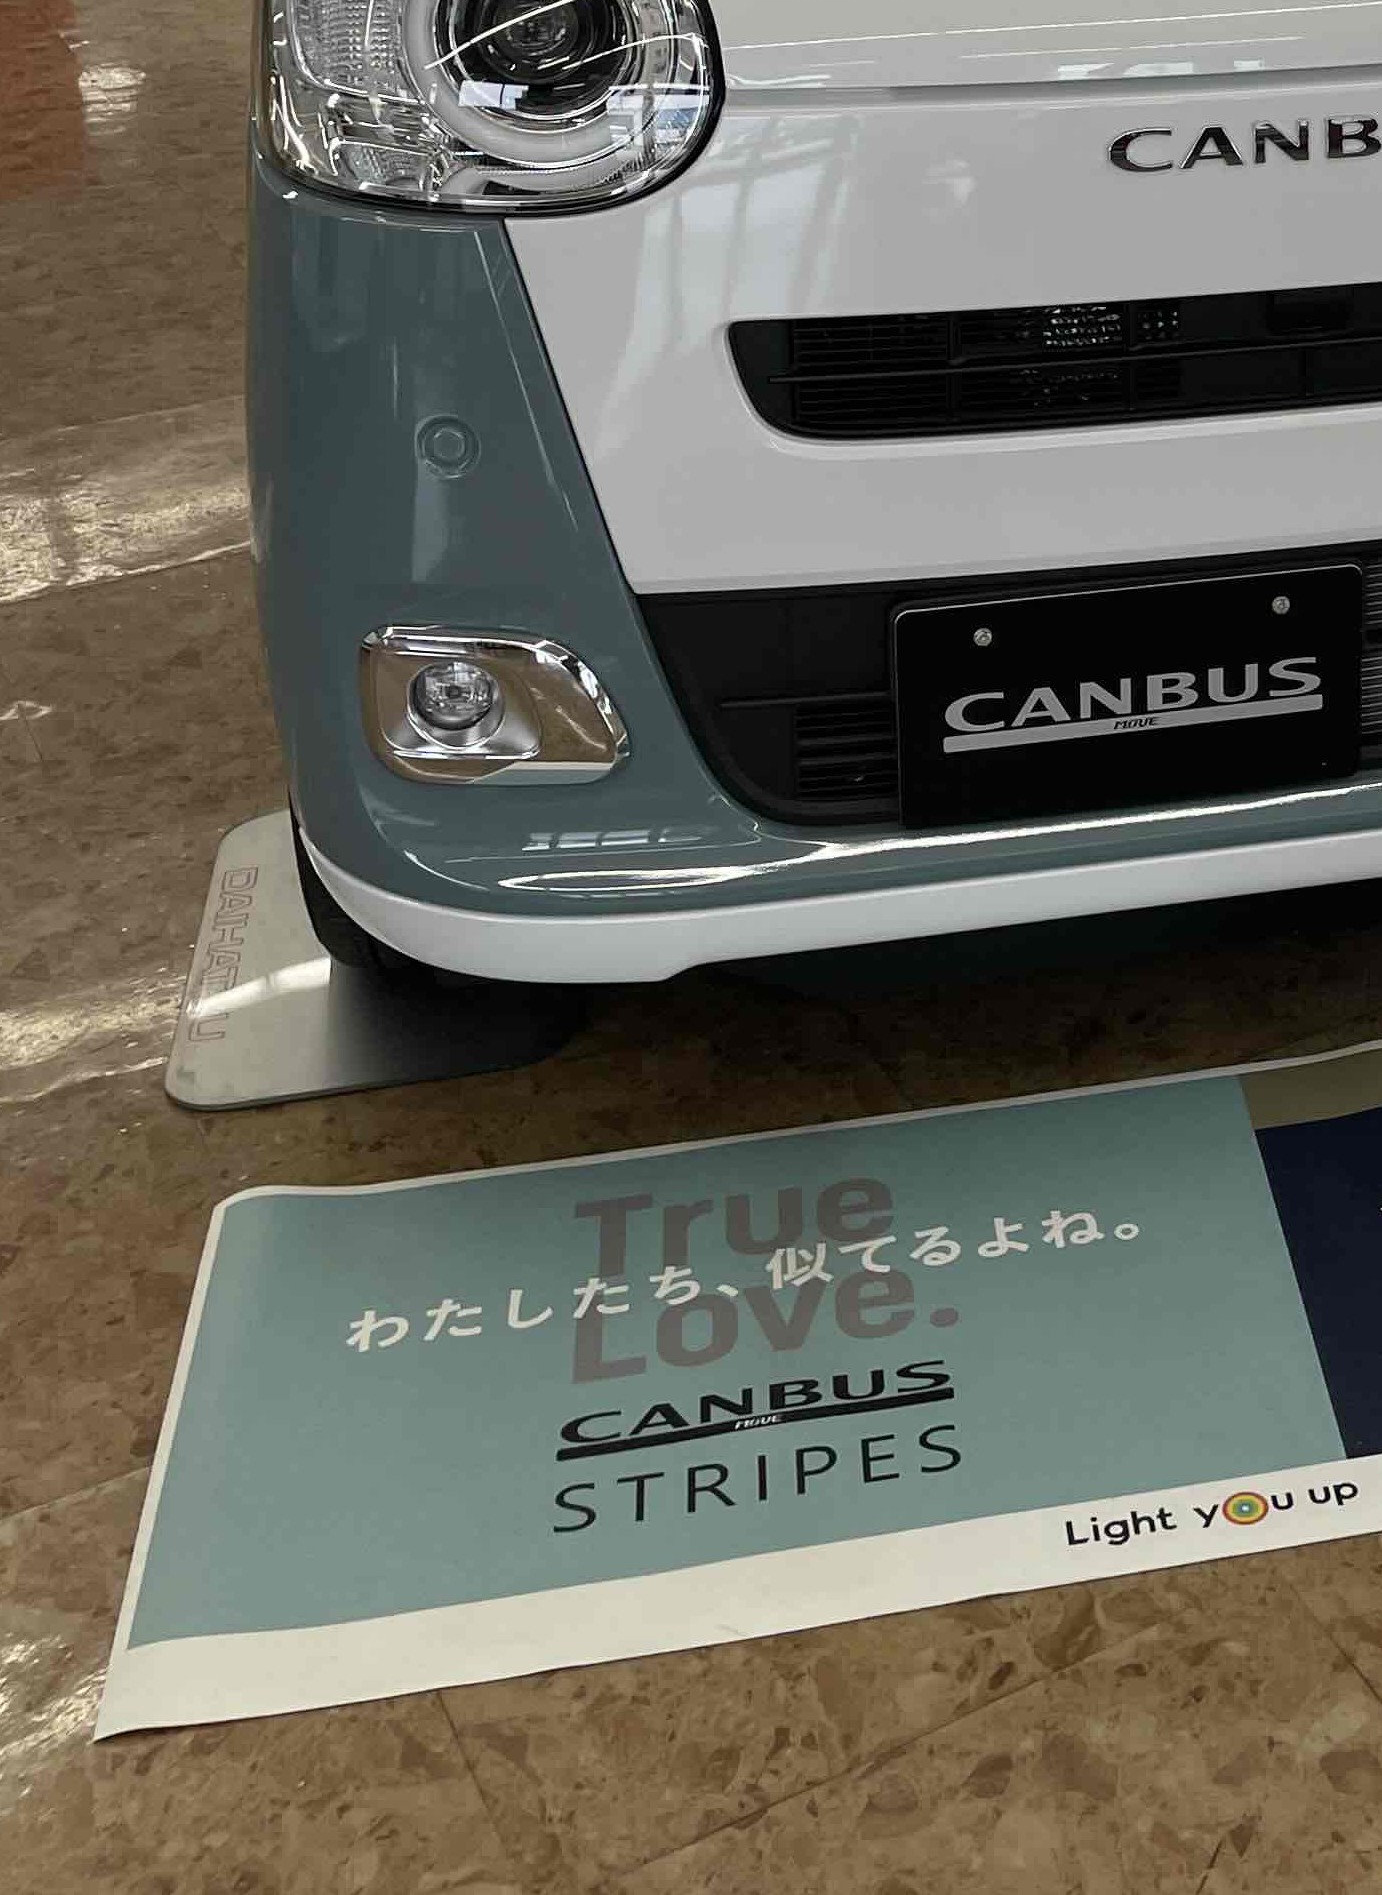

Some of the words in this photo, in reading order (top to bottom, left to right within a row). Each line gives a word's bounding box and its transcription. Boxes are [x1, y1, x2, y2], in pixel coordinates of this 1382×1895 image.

[944, 657, 1322, 732] CANBUS
[1113, 717, 1159, 730] MOVE
[188, 866, 259, 1043] DAIHATU
[571, 1174, 894, 1272] True
[345, 1208, 1140, 1354] わたしたち、似てるよね。
[571, 1261, 959, 1384] Love.
[557, 1359, 952, 1444] CANBUS
[735, 1413, 783, 1430] MOVE
[553, 1422, 963, 1534] STRIPES
[1065, 1507, 1177, 1546] Light
[1309, 1479, 1359, 1508] up
